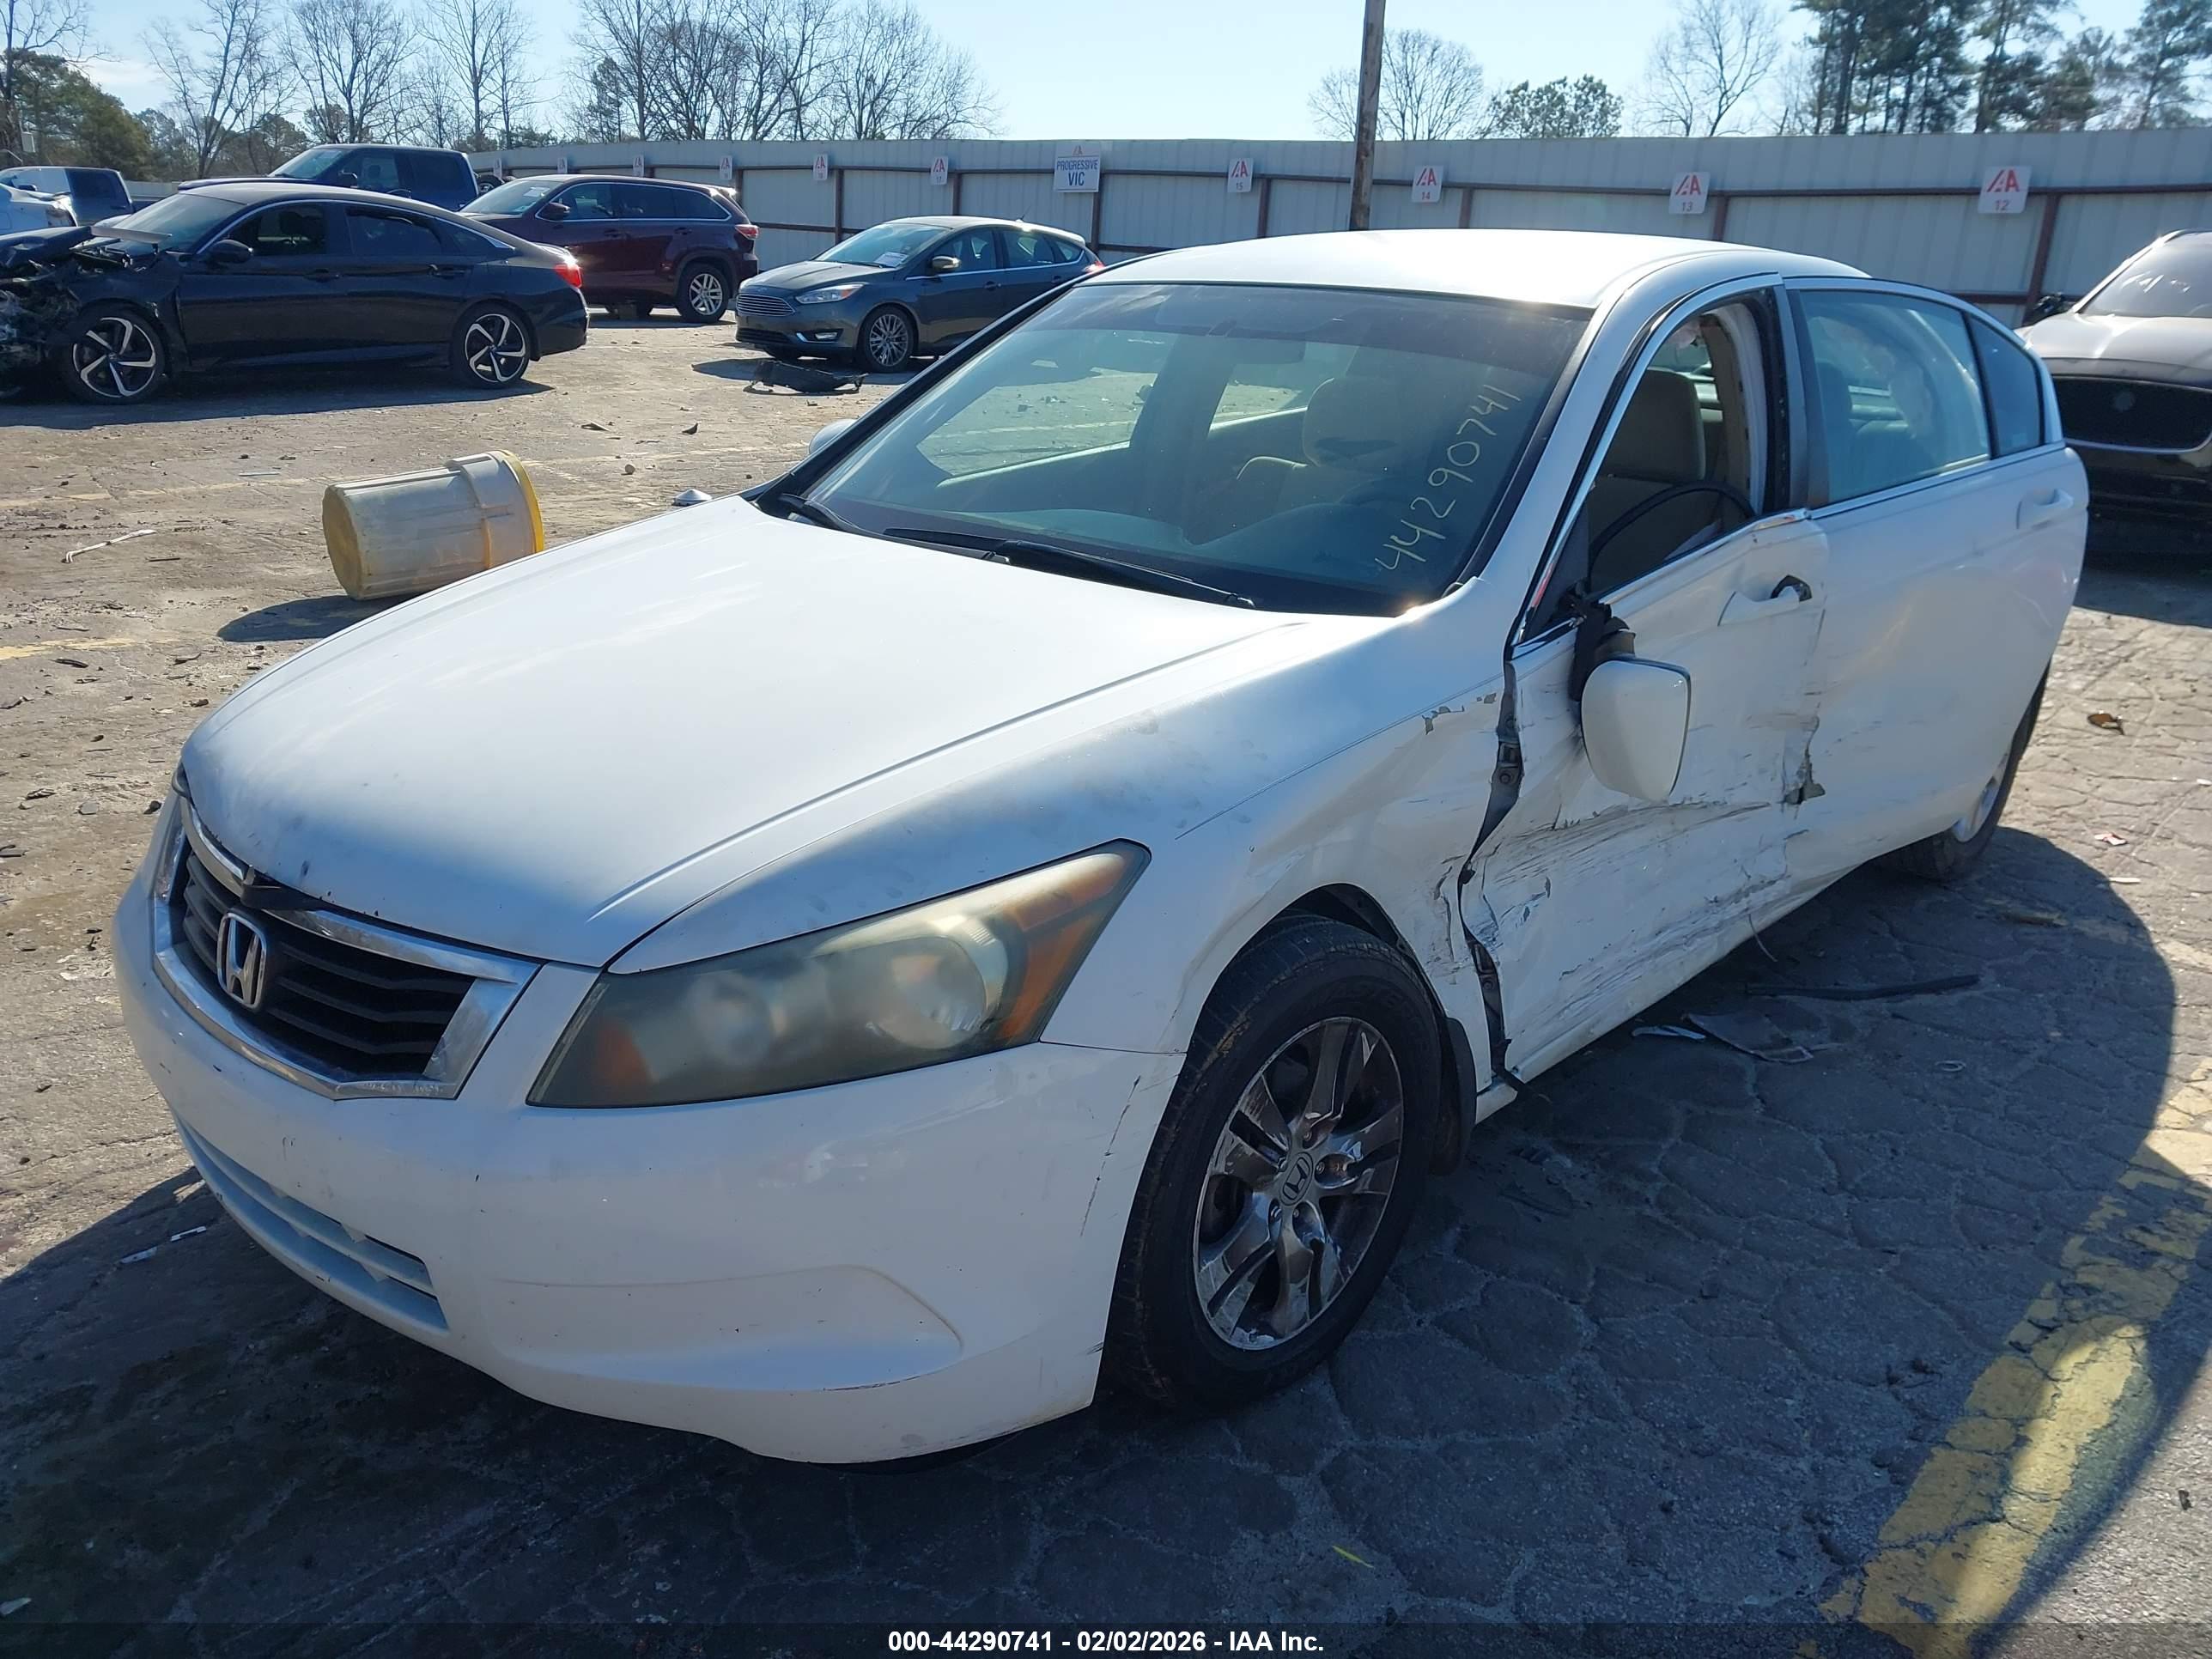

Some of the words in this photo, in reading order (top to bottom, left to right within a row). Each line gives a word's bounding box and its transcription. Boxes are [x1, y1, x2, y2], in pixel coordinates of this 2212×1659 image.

[1056, 159, 1099, 171] PROGRESSIVE
[1068, 171, 1085, 186] VIC
[1236, 182, 1244, 191] 15
[1421, 191, 1431, 200] 14
[1681, 201, 1693, 212] 13
[1994, 199, 2011, 211] 12
[1374, 384, 1522, 571] 44290741
